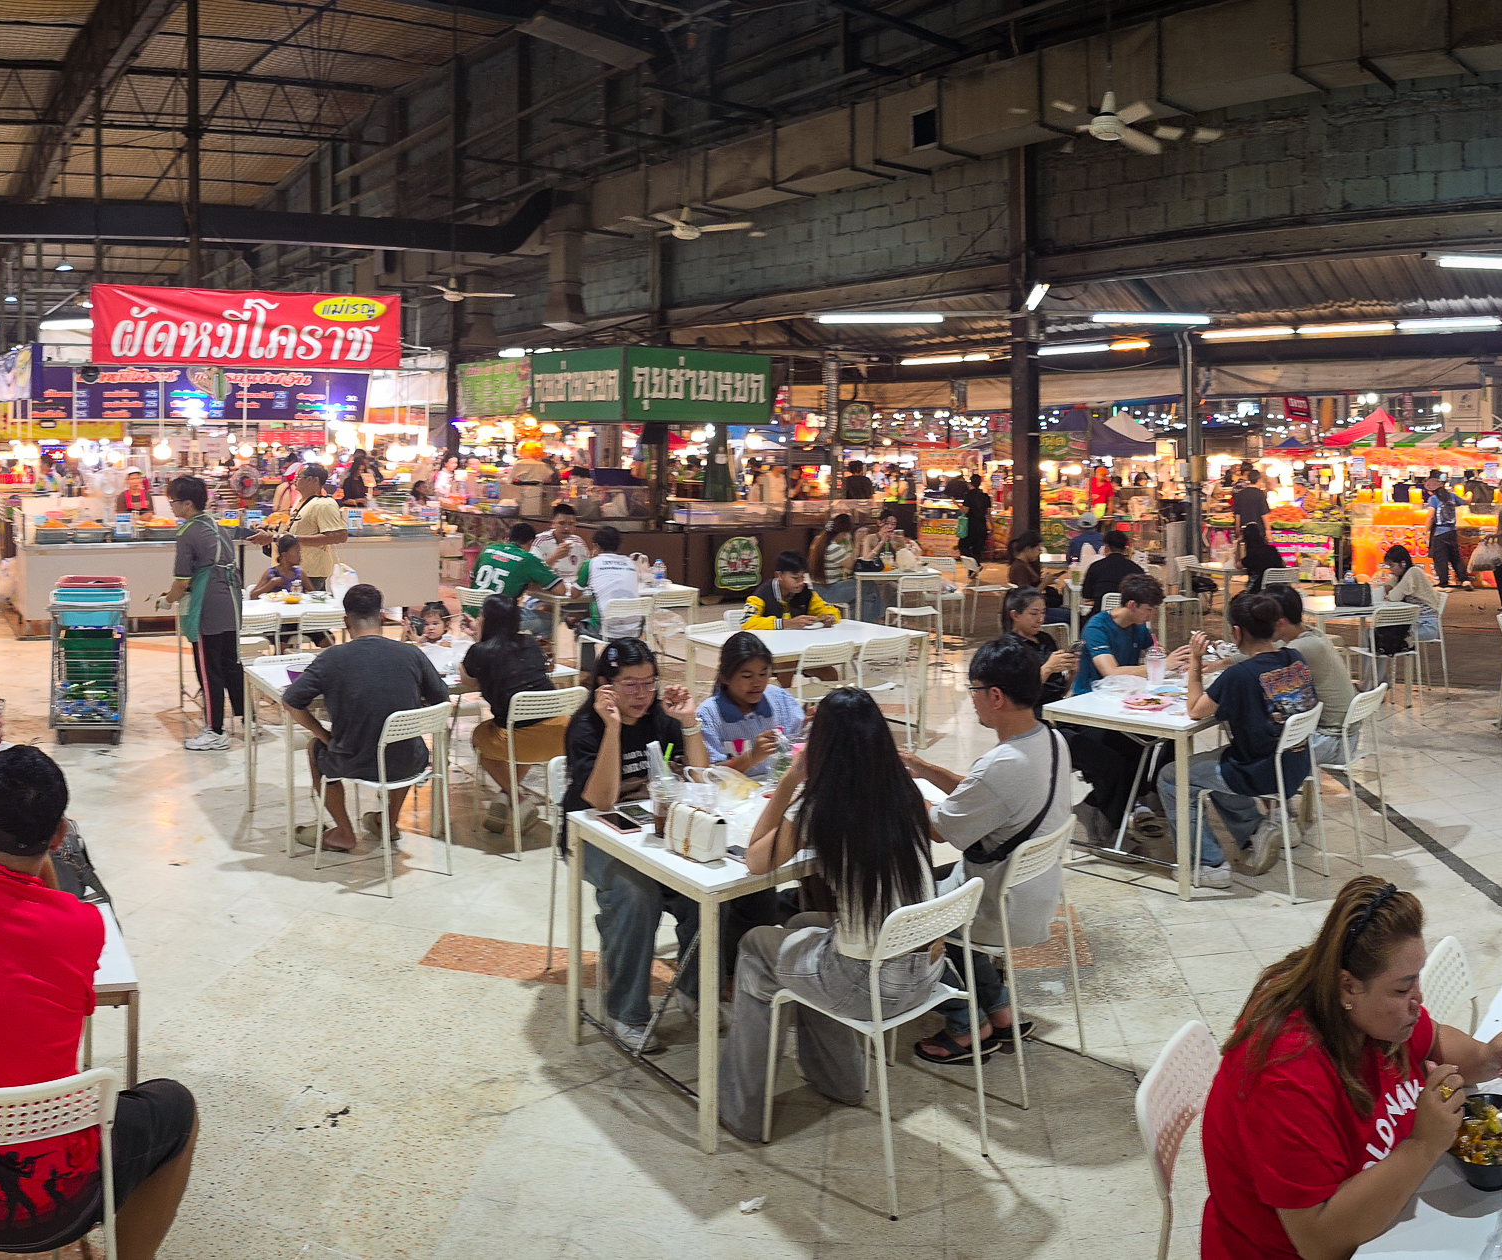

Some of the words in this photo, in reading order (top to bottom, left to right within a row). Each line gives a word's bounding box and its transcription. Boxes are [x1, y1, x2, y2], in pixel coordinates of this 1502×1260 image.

[321, 299, 378, 319] แม่เรณู
[111, 298, 380, 361] ผัดหมี่โคราช
[475, 565, 510, 595] 95
